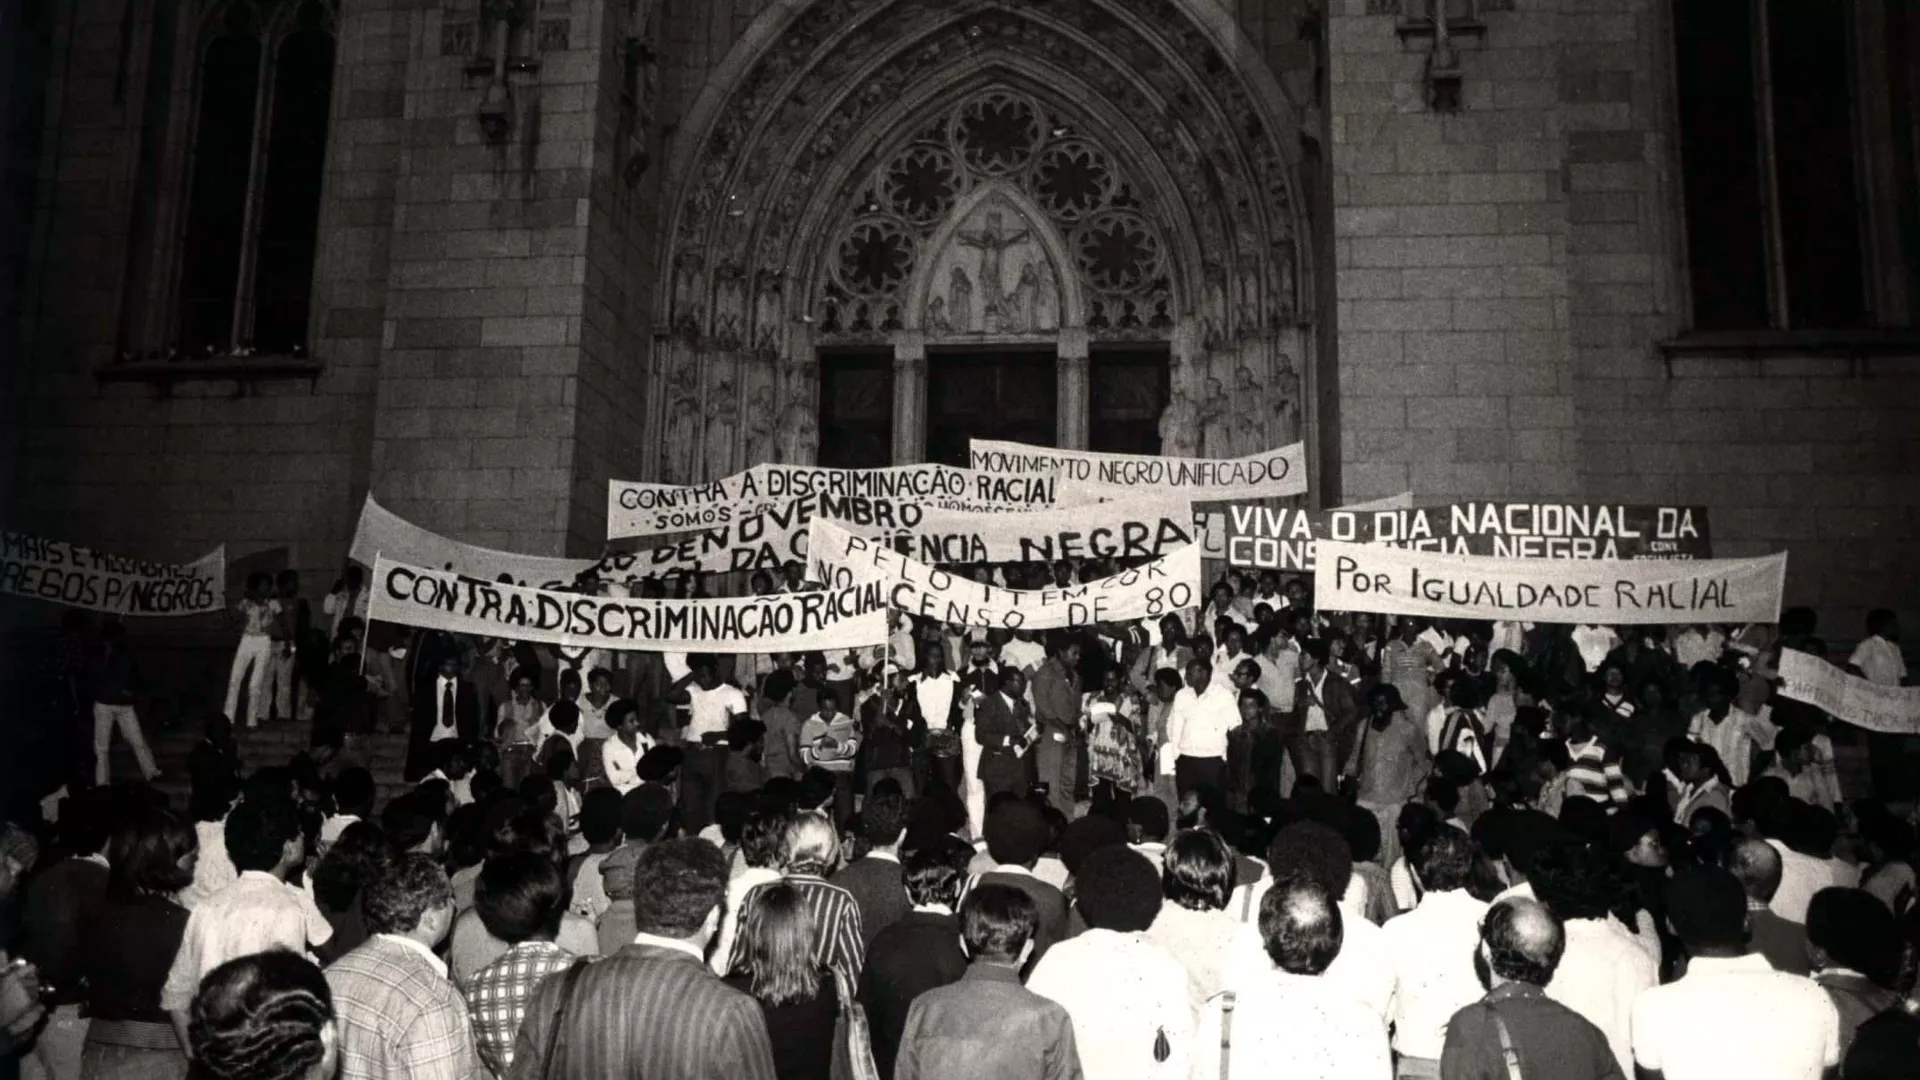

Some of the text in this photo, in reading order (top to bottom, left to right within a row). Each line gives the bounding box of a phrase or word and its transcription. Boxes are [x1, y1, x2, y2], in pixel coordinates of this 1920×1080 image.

[619, 481, 729, 510] CONTRA
[740, 471, 759, 500] A
[977, 474, 1056, 504] RACIAL
[971, 451, 1289, 487] MOVIMENTO NEGRO UNIFICADO
[655, 506, 732, 530] SOMOS
[1231, 505, 1312, 540] VIVA
[1331, 511, 1356, 541] O
[1374, 508, 1433, 542] DIA
[1451, 502, 1641, 539] NACIONAL
[1656, 506, 1699, 539] DA
[651, 539, 697, 564] DE
[729, 541, 782, 571] DA
[1019, 517, 1193, 562] NEGRA
[846, 535, 952, 591] PELO
[1493, 535, 1620, 561] NEGRA
[0, 560, 99, 606] REGOS
[1336, 555, 1392, 595] POR
[1411, 567, 1600, 608] IGUALDADE
[792, 578, 889, 634] RACIAL
[890, 582, 1026, 633] CENSO
[1145, 581, 1191, 615] 80
